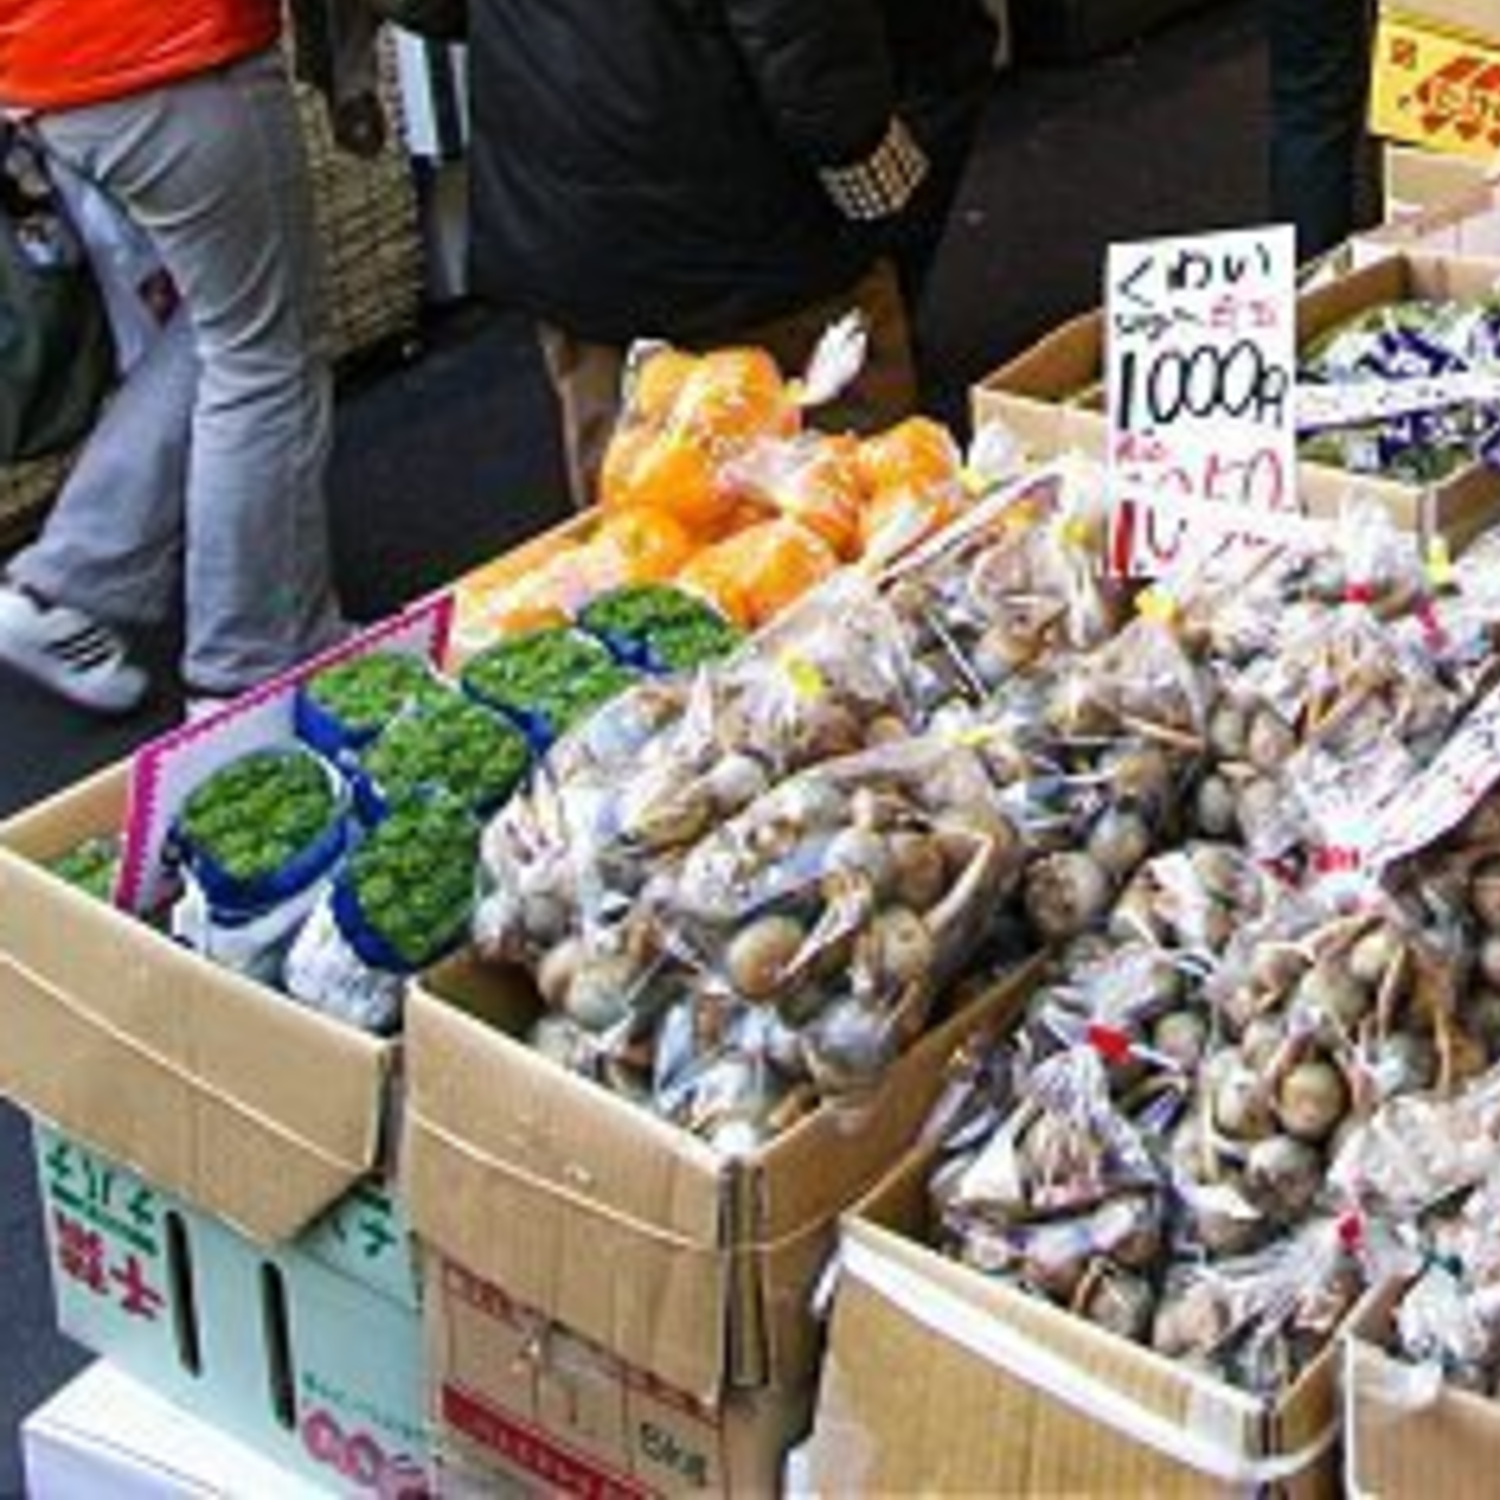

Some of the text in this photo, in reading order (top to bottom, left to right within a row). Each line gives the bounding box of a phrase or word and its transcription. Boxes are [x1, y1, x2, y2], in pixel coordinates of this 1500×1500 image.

[1115, 242, 1273, 308] くわい
[1115, 338, 1290, 430] 1000円
